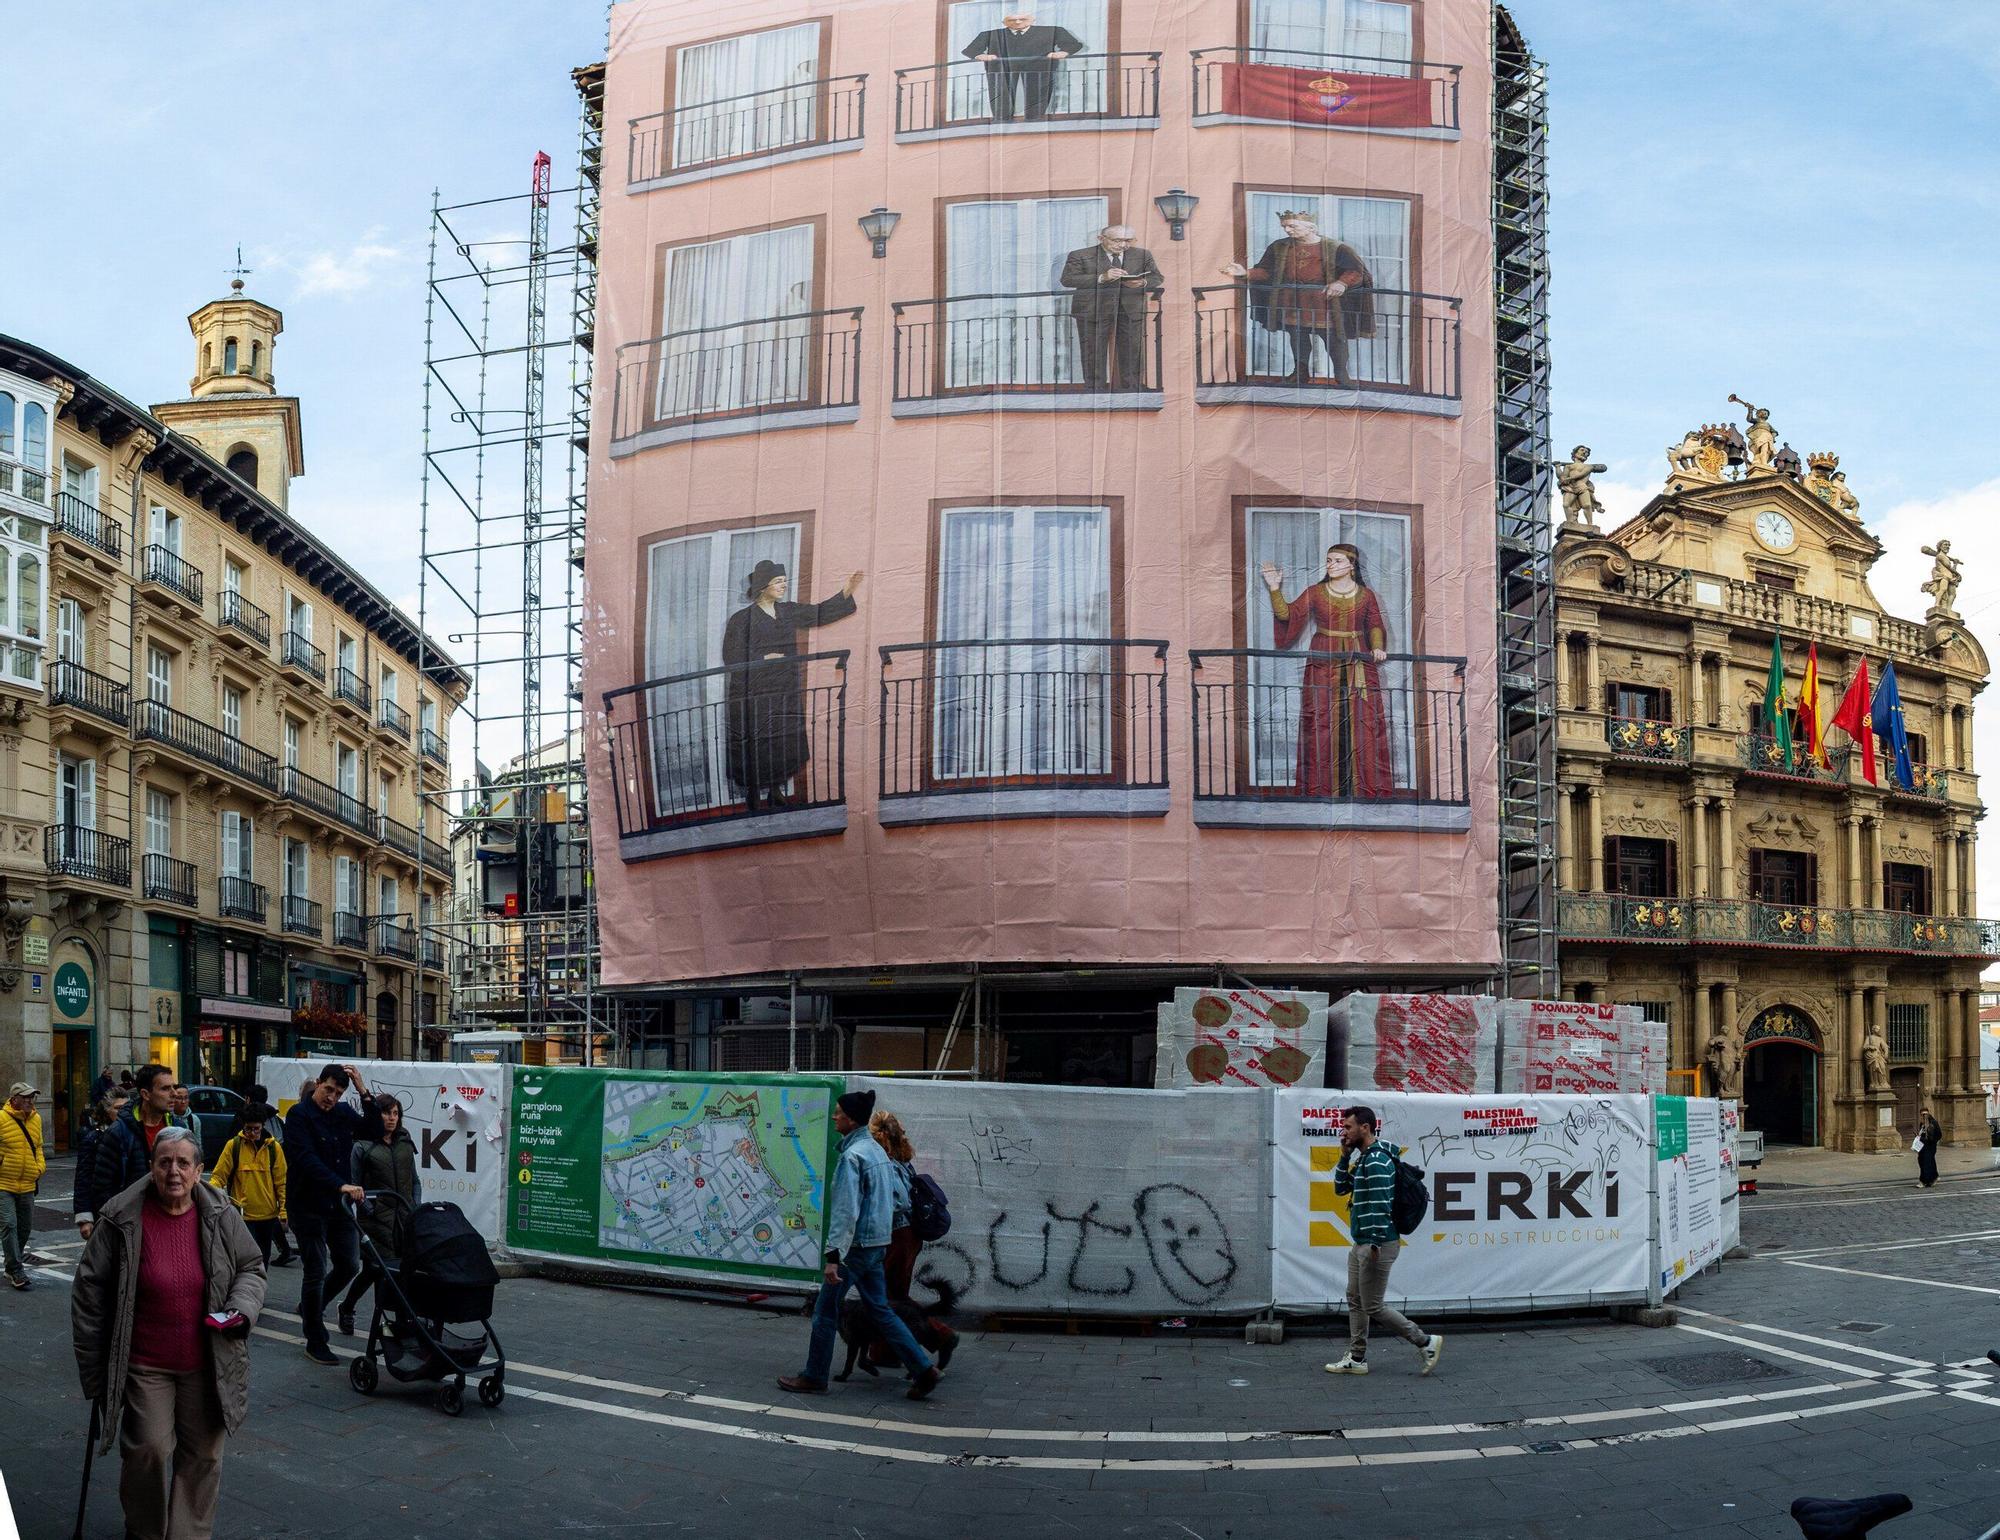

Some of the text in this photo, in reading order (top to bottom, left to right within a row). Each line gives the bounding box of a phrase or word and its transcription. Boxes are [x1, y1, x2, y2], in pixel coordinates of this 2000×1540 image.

[67, 976, 77, 986] LA
[57, 986, 88, 998] INFANTIL
[1239, 998, 1272, 1021] ROCKWOOL
[1532, 1002, 1596, 1015] ROCKWOOL
[1235, 1073, 1262, 1087] ROCKW
[1555, 1077, 1620, 1090] ROCKWOOL
[521, 1101, 563, 1112] pamplona
[1303, 1108, 1345, 1119] PALEST
[1464, 1108, 1524, 1120] PALESTINA
[1491, 1117, 1538, 1128] ASKATU!
[520, 1125, 563, 1136] bizi-bizirik
[1302, 1128, 1337, 1137] ISRAELI
[1464, 1126, 1538, 1138] ISRAELI BOIKOT
[519, 1136, 555, 1146] muy viva
